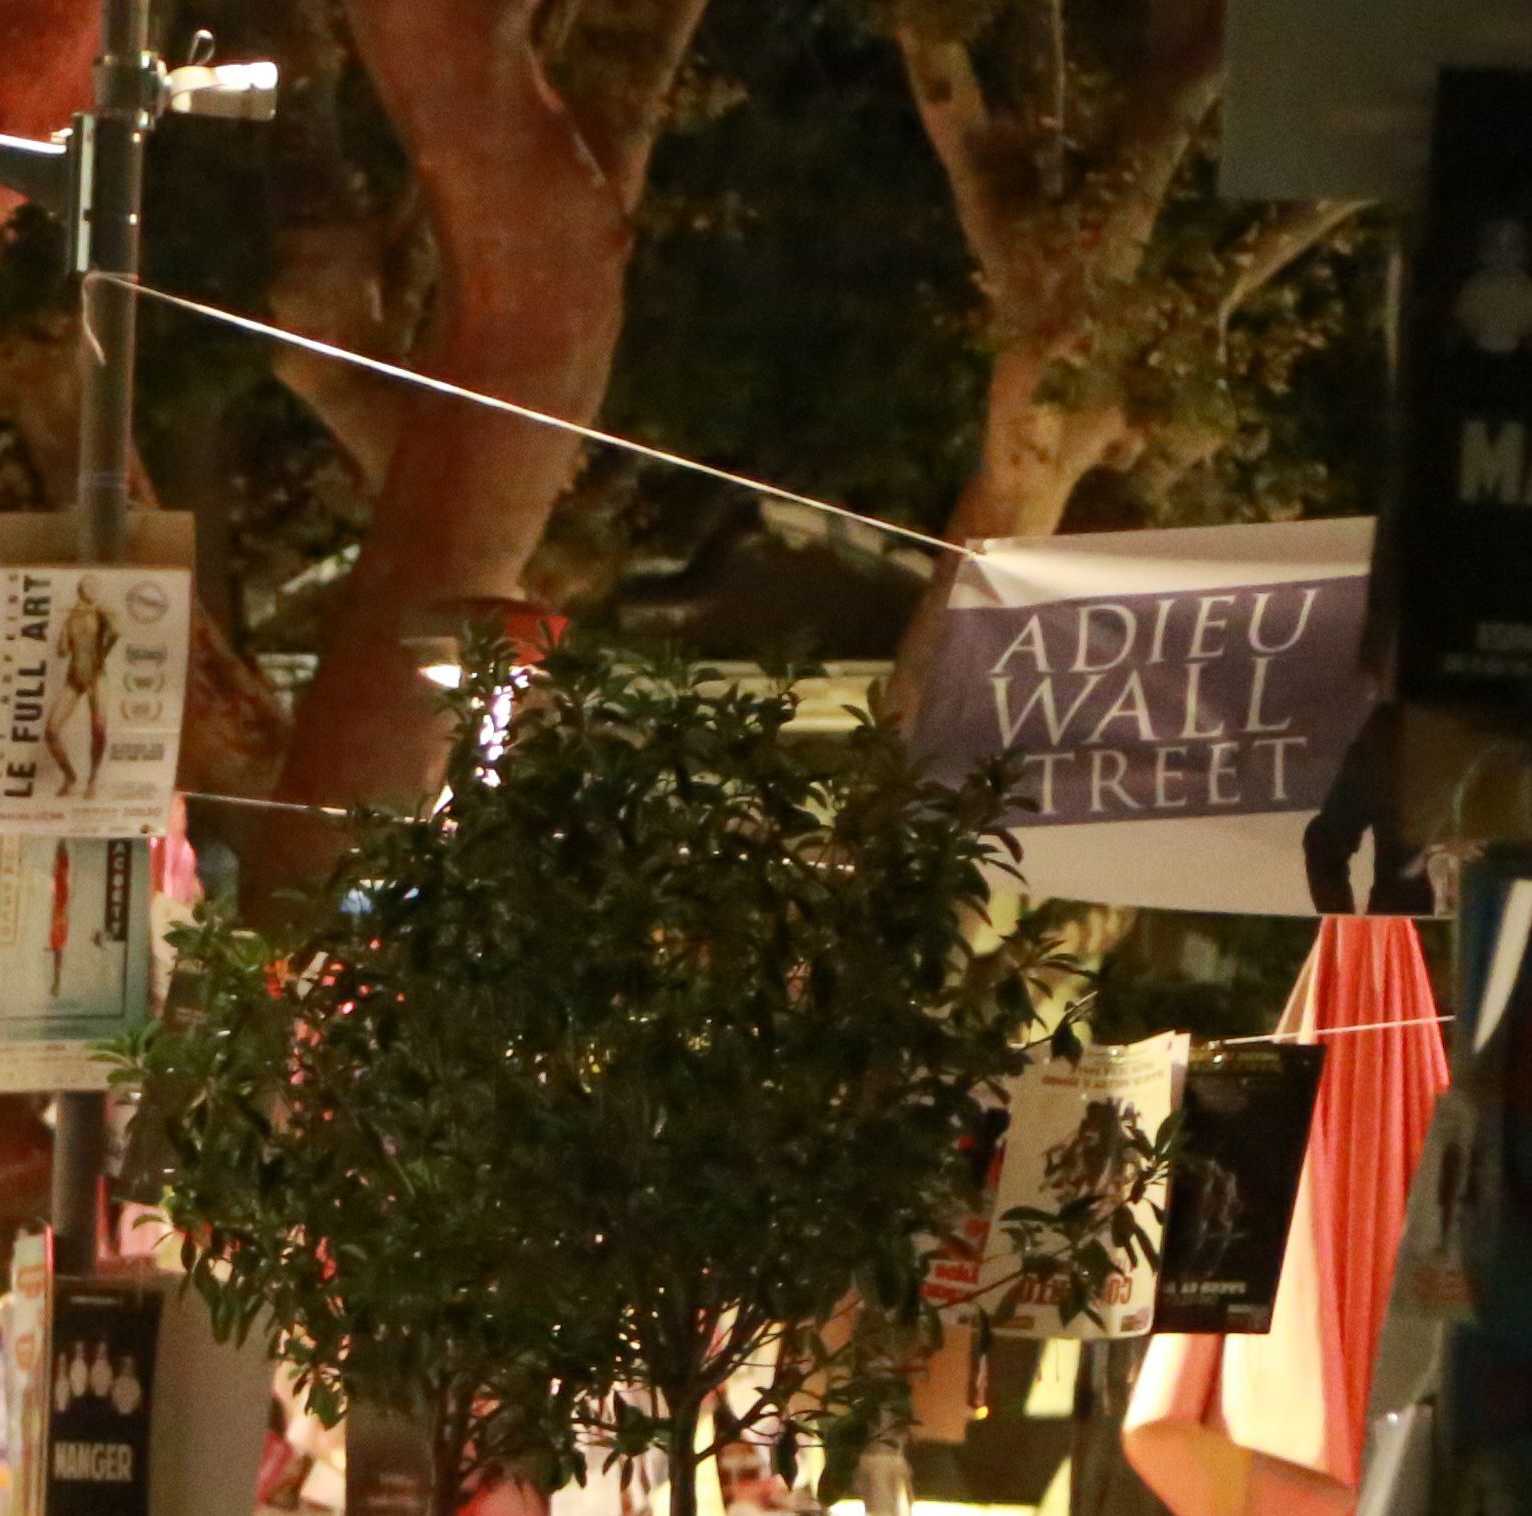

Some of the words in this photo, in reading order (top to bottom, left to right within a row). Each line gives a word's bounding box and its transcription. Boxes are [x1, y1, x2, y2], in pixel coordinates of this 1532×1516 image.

[21, 574, 51, 643] ART
[990, 589, 1319, 675] ADIEU
[11, 659, 47, 745] FULL
[990, 657, 1293, 750] WALL
[3, 761, 35, 798] LE
[1023, 736, 1309, 817] TREET
